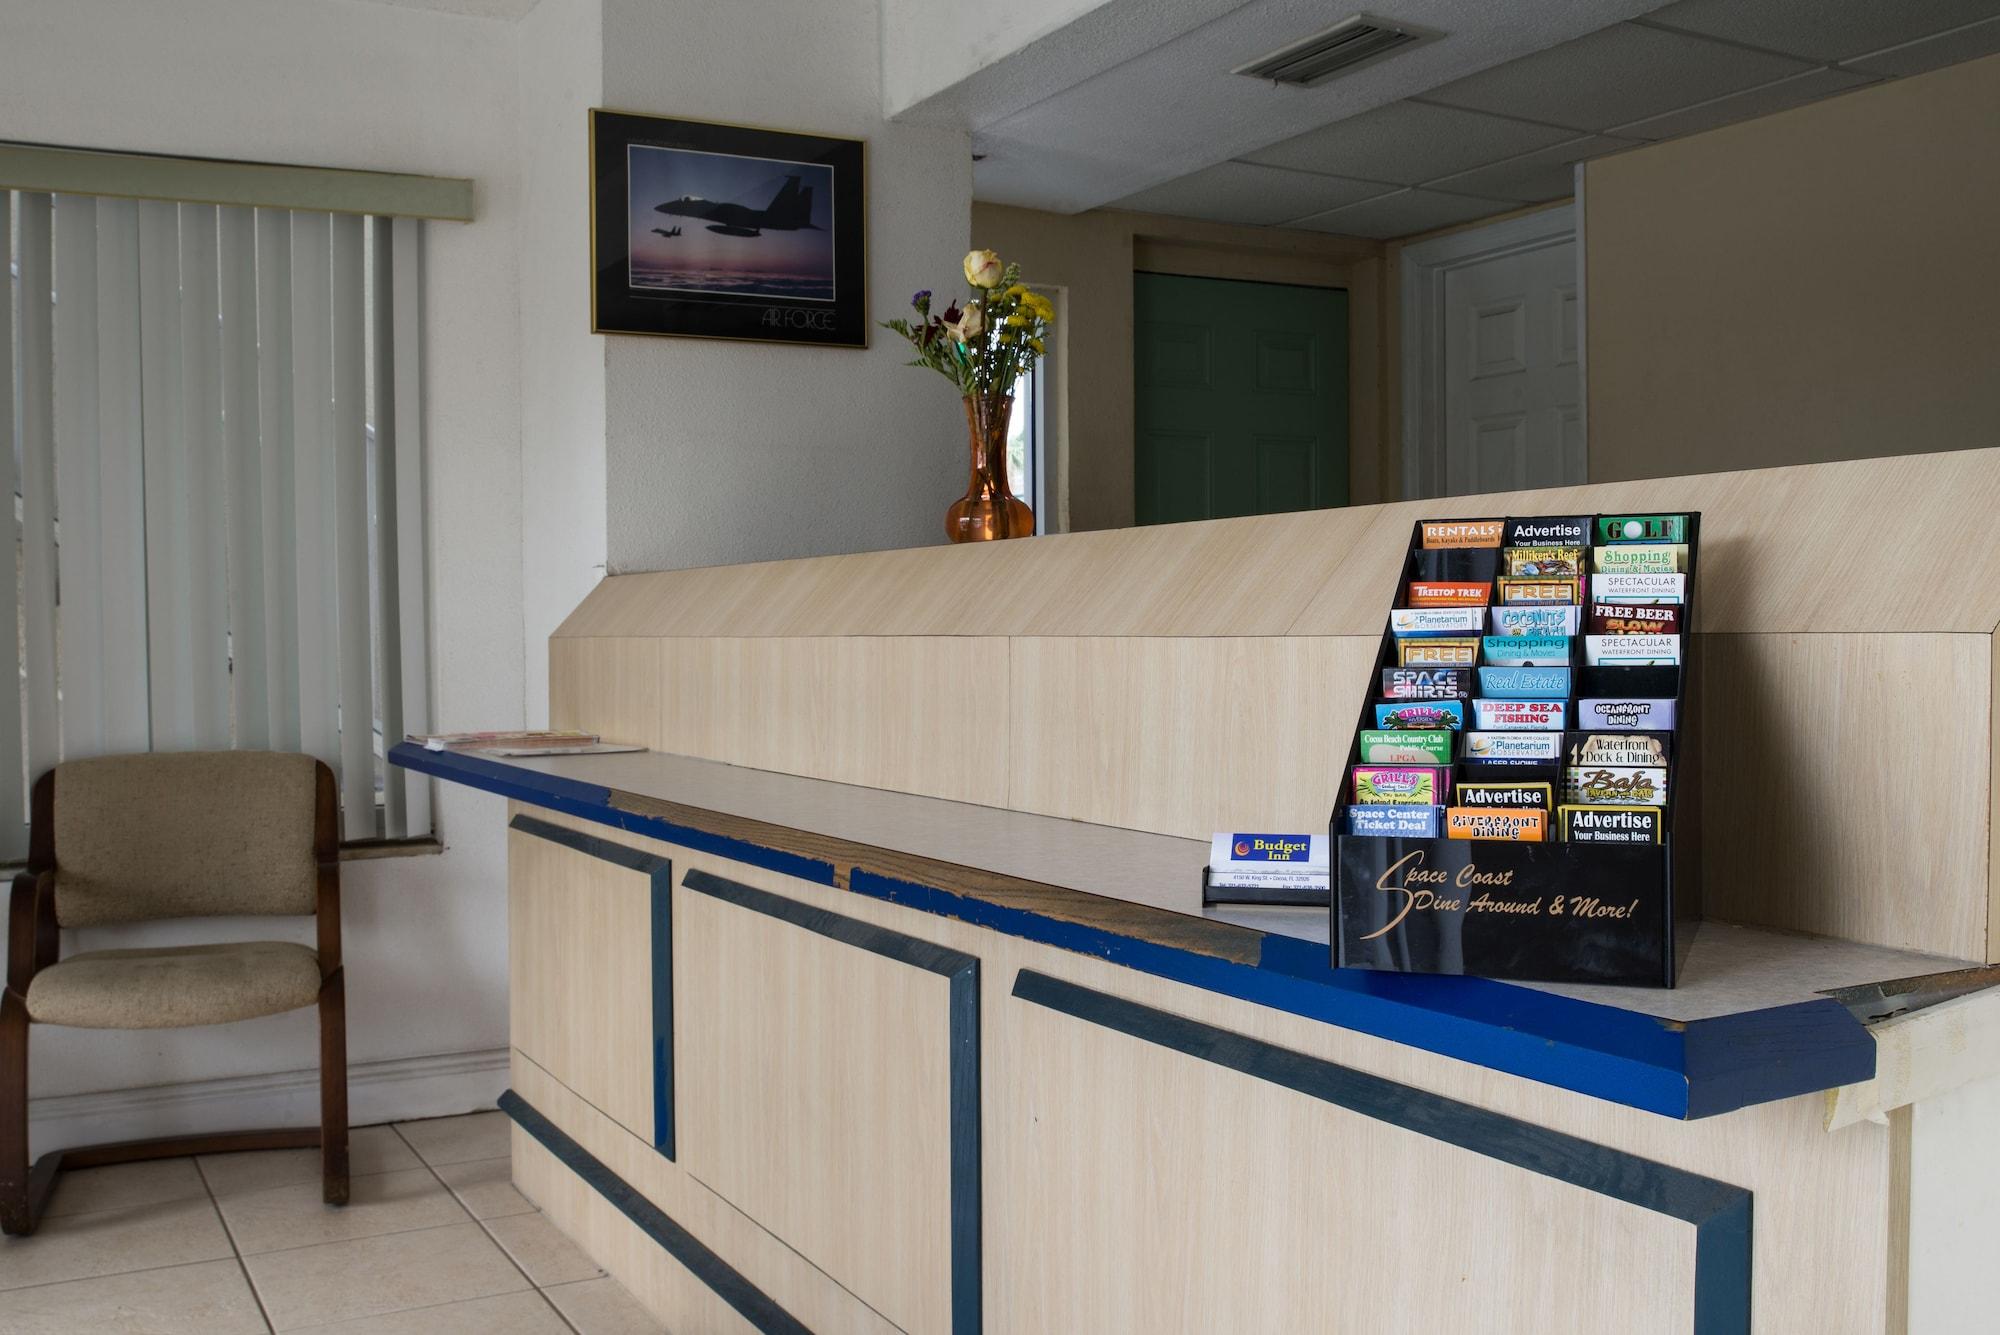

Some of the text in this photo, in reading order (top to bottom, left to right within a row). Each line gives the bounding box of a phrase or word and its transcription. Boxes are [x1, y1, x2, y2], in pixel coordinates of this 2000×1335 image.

[762, 305, 837, 331] AIR FORCE
[1427, 525, 1495, 537] RENTALS
[1514, 524, 1581, 537] Advertise
[1512, 548, 1578, 561] Milliken's Reef
[1604, 550, 1671, 564] Shopping
[1601, 566, 1630, 574] Dining
[1643, 565, 1673, 573] Movies
[1608, 577, 1676, 586] SPECTACULAR
[1457, 588, 1482, 597] TREK
[1507, 585, 1569, 600] FREE
[1419, 615, 1468, 624] Planetarium
[1502, 608, 1566, 628] COCONUTS
[1595, 605, 1675, 621] FREE BEER
[1606, 619, 1665, 632] SLOW
[1487, 638, 1565, 650] Shopping
[1601, 638, 1672, 647] SPECTACULAR
[1408, 647, 1470, 662] FREE
[1497, 650, 1522, 658] Dining
[1531, 649, 1556, 657] Movies
[1393, 670, 1458, 685] SPACE
[1486, 671, 1564, 689] Real Estate
[1393, 685, 1458, 698] SHIRTS
[1482, 703, 1563, 713] DEEP SEA
[1595, 703, 1651, 714] OCEANFRONT
[1494, 714, 1550, 724] FISHING
[1364, 734, 1444, 746] Cocoa Beach Country Club
[1496, 740, 1550, 750] Planetarium
[1596, 739, 1649, 751] Waterfront
[1586, 751, 1660, 765] Dock & Dining
[1371, 771, 1419, 785] GRILLS
[1582, 769, 1657, 792] Baja
[1465, 788, 1542, 804] Advertise
[1349, 808, 1430, 820] Space Center
[1573, 811, 1652, 829] Advertise
[1355, 820, 1426, 830] Ticket Deal
[1574, 830, 1651, 842] Your Business Here
[1253, 839, 1307, 854] Budget
[1267, 850, 1290, 861] Inn
[1455, 863, 1514, 888] Coast
[1413, 889, 1640, 919] Dine Around & More!
